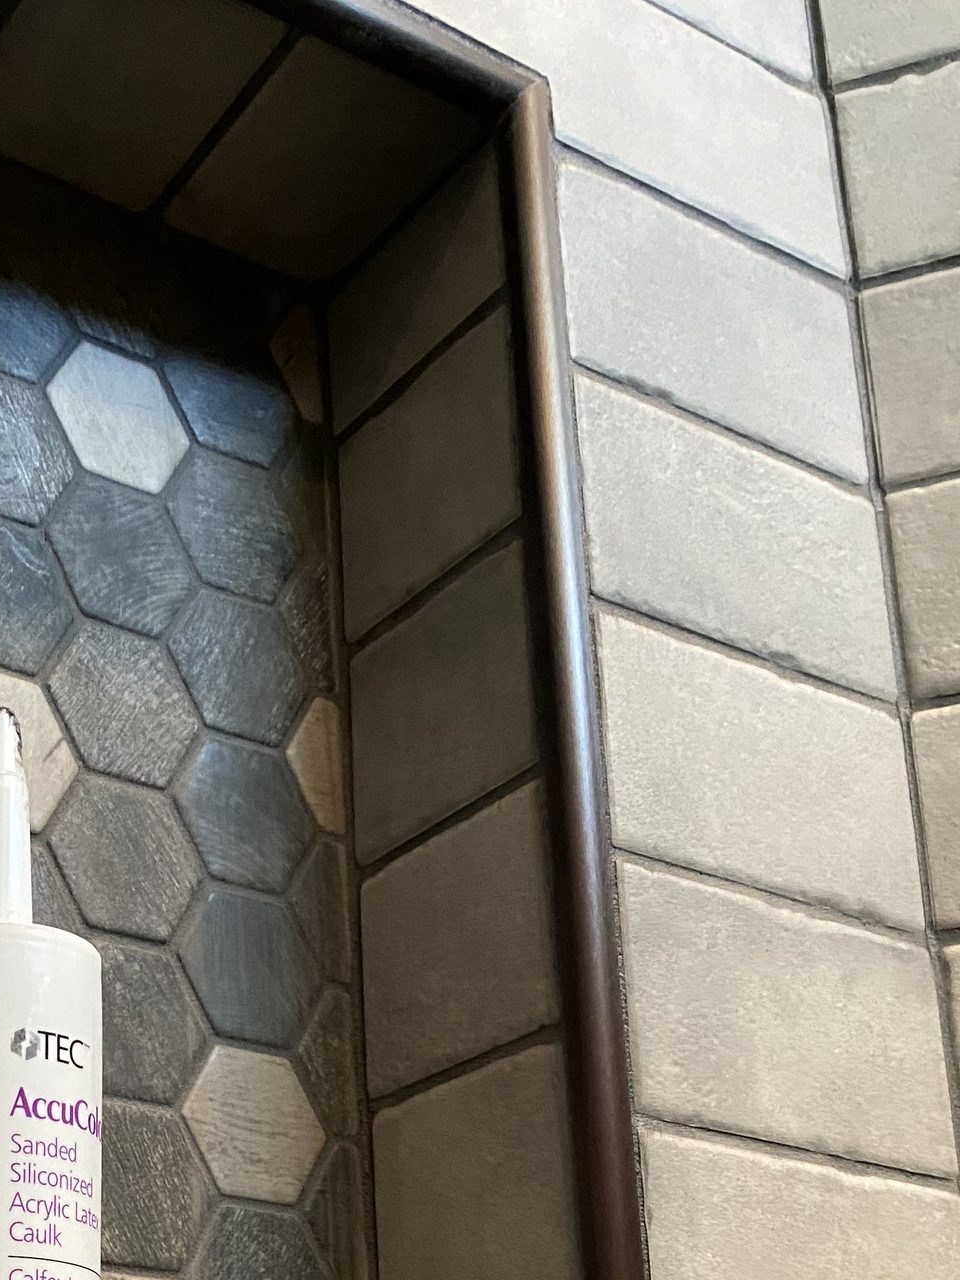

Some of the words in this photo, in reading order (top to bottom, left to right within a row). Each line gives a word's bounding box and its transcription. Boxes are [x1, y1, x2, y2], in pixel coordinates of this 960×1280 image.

[37, 1030, 84, 1070] TEC
[10, 1133, 77, 1163] Sanded
[10, 1162, 93, 1198] Siliconized
[9, 1191, 70, 1220] Acrylic
[9, 1221, 62, 1247] Caulk
